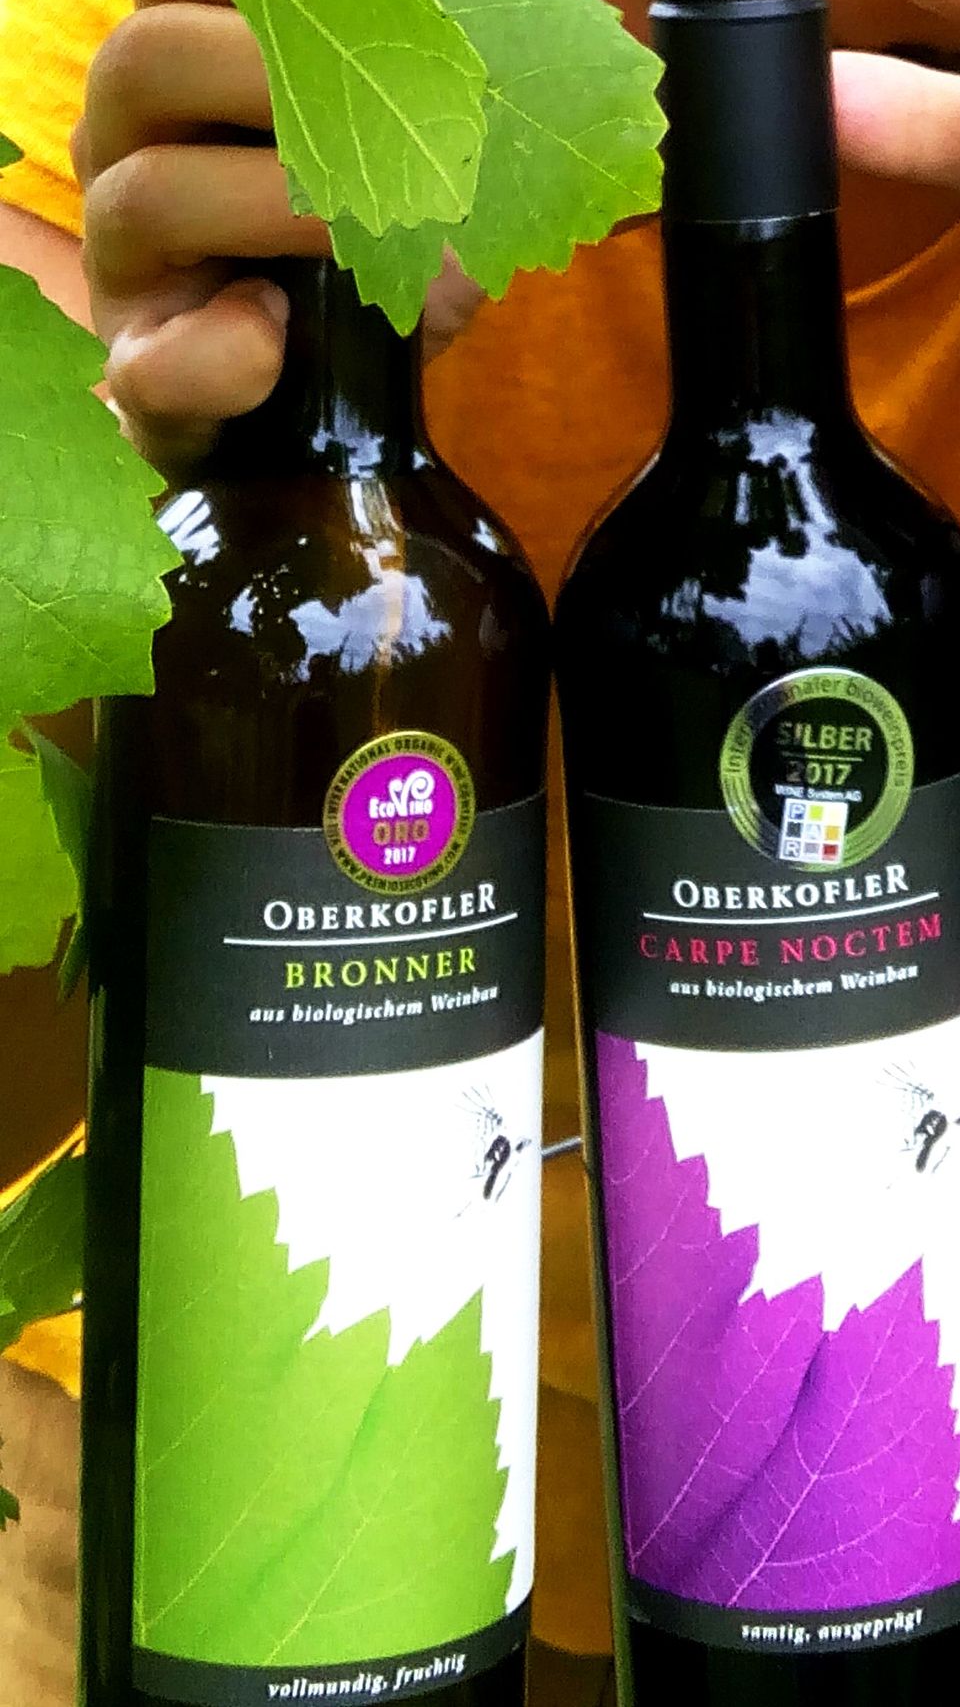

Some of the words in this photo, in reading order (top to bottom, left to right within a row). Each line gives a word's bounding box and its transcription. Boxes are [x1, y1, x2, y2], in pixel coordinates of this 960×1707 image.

[777, 722, 874, 752] SILBER
[786, 763, 852, 786] 2017
[373, 819, 429, 845] ORO
[384, 846, 416, 865] 2017
[639, 935, 760, 967] CARPE
[780, 913, 942, 965] NOCTEM
[286, 947, 478, 990] BRONNER
[670, 980, 700, 996] aus
[706, 977, 834, 1003] biologischem
[839, 964, 919, 991] Weinbau
[250, 1007, 285, 1023] aus
[292, 997, 424, 1026] biologischem
[431, 985, 498, 1013] Weinbau
[741, 1623, 811, 1646] samtig,
[817, 1608, 923, 1642] ausgeprägt
[268, 1672, 388, 1699] vollmundig,
[393, 1653, 466, 1692] fruchtig
